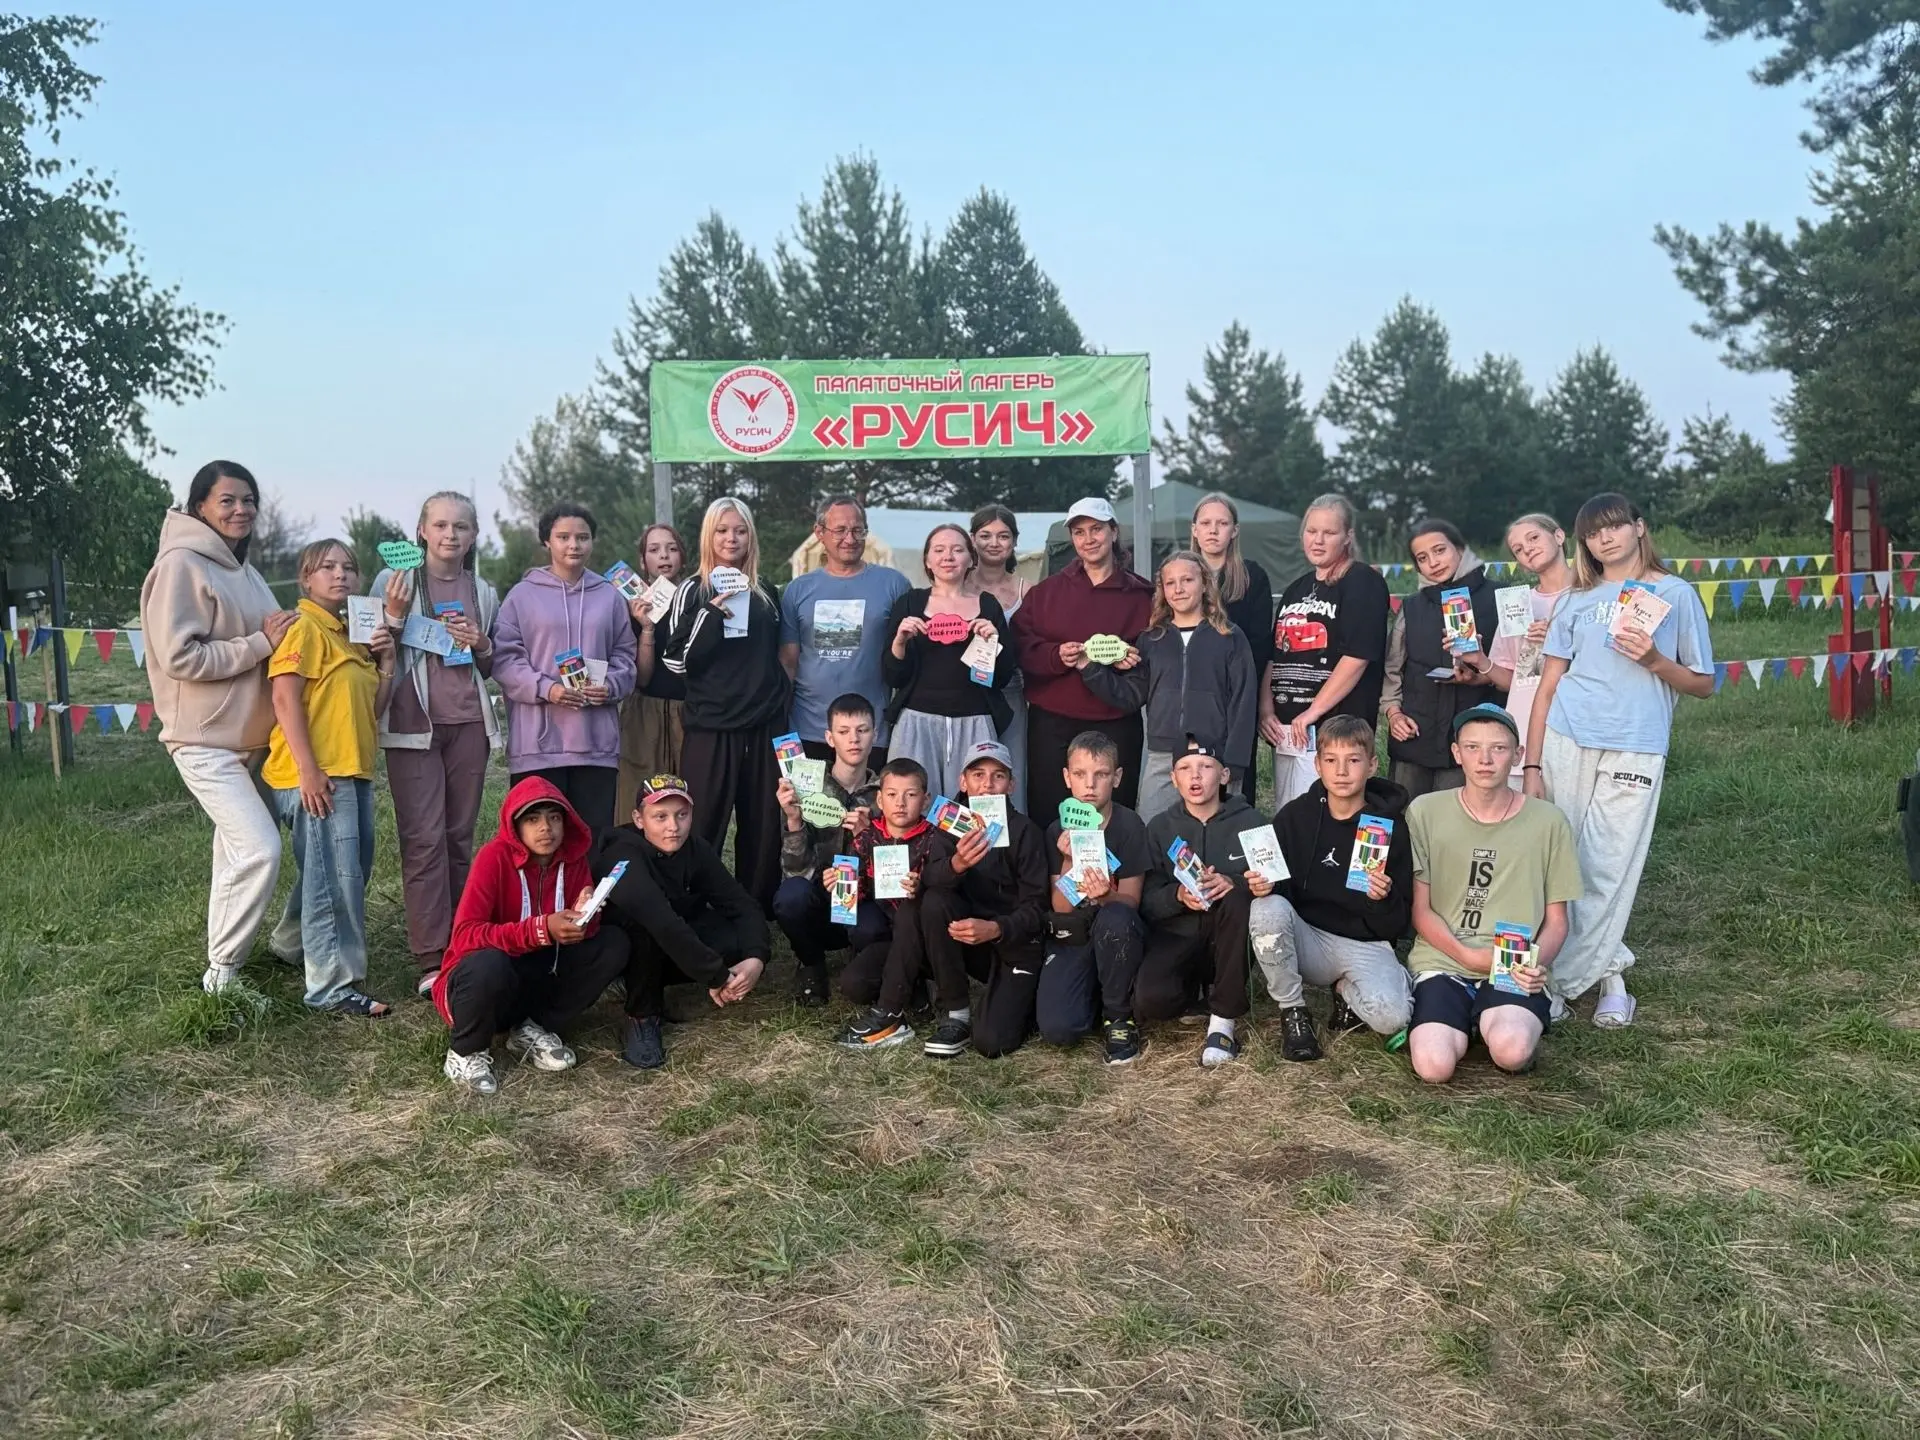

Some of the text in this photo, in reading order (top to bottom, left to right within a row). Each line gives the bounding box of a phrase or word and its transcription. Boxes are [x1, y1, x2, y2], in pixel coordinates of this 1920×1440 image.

[815, 370, 1054, 393] ПАЛАТОЧНЫЙ ЛАГЕРЬ
[735, 427, 772, 437] РУСИЧ
[811, 400, 1096, 449] «РУСИЧ»
[1613, 771, 1653, 787] SCULPTOR
[1474, 849, 1496, 858] SIMPLE
[1469, 861, 1494, 888] IS
[1467, 888, 1488, 898] BEING
[1465, 898, 1486, 909] MADE
[1460, 909, 1482, 930] TO
